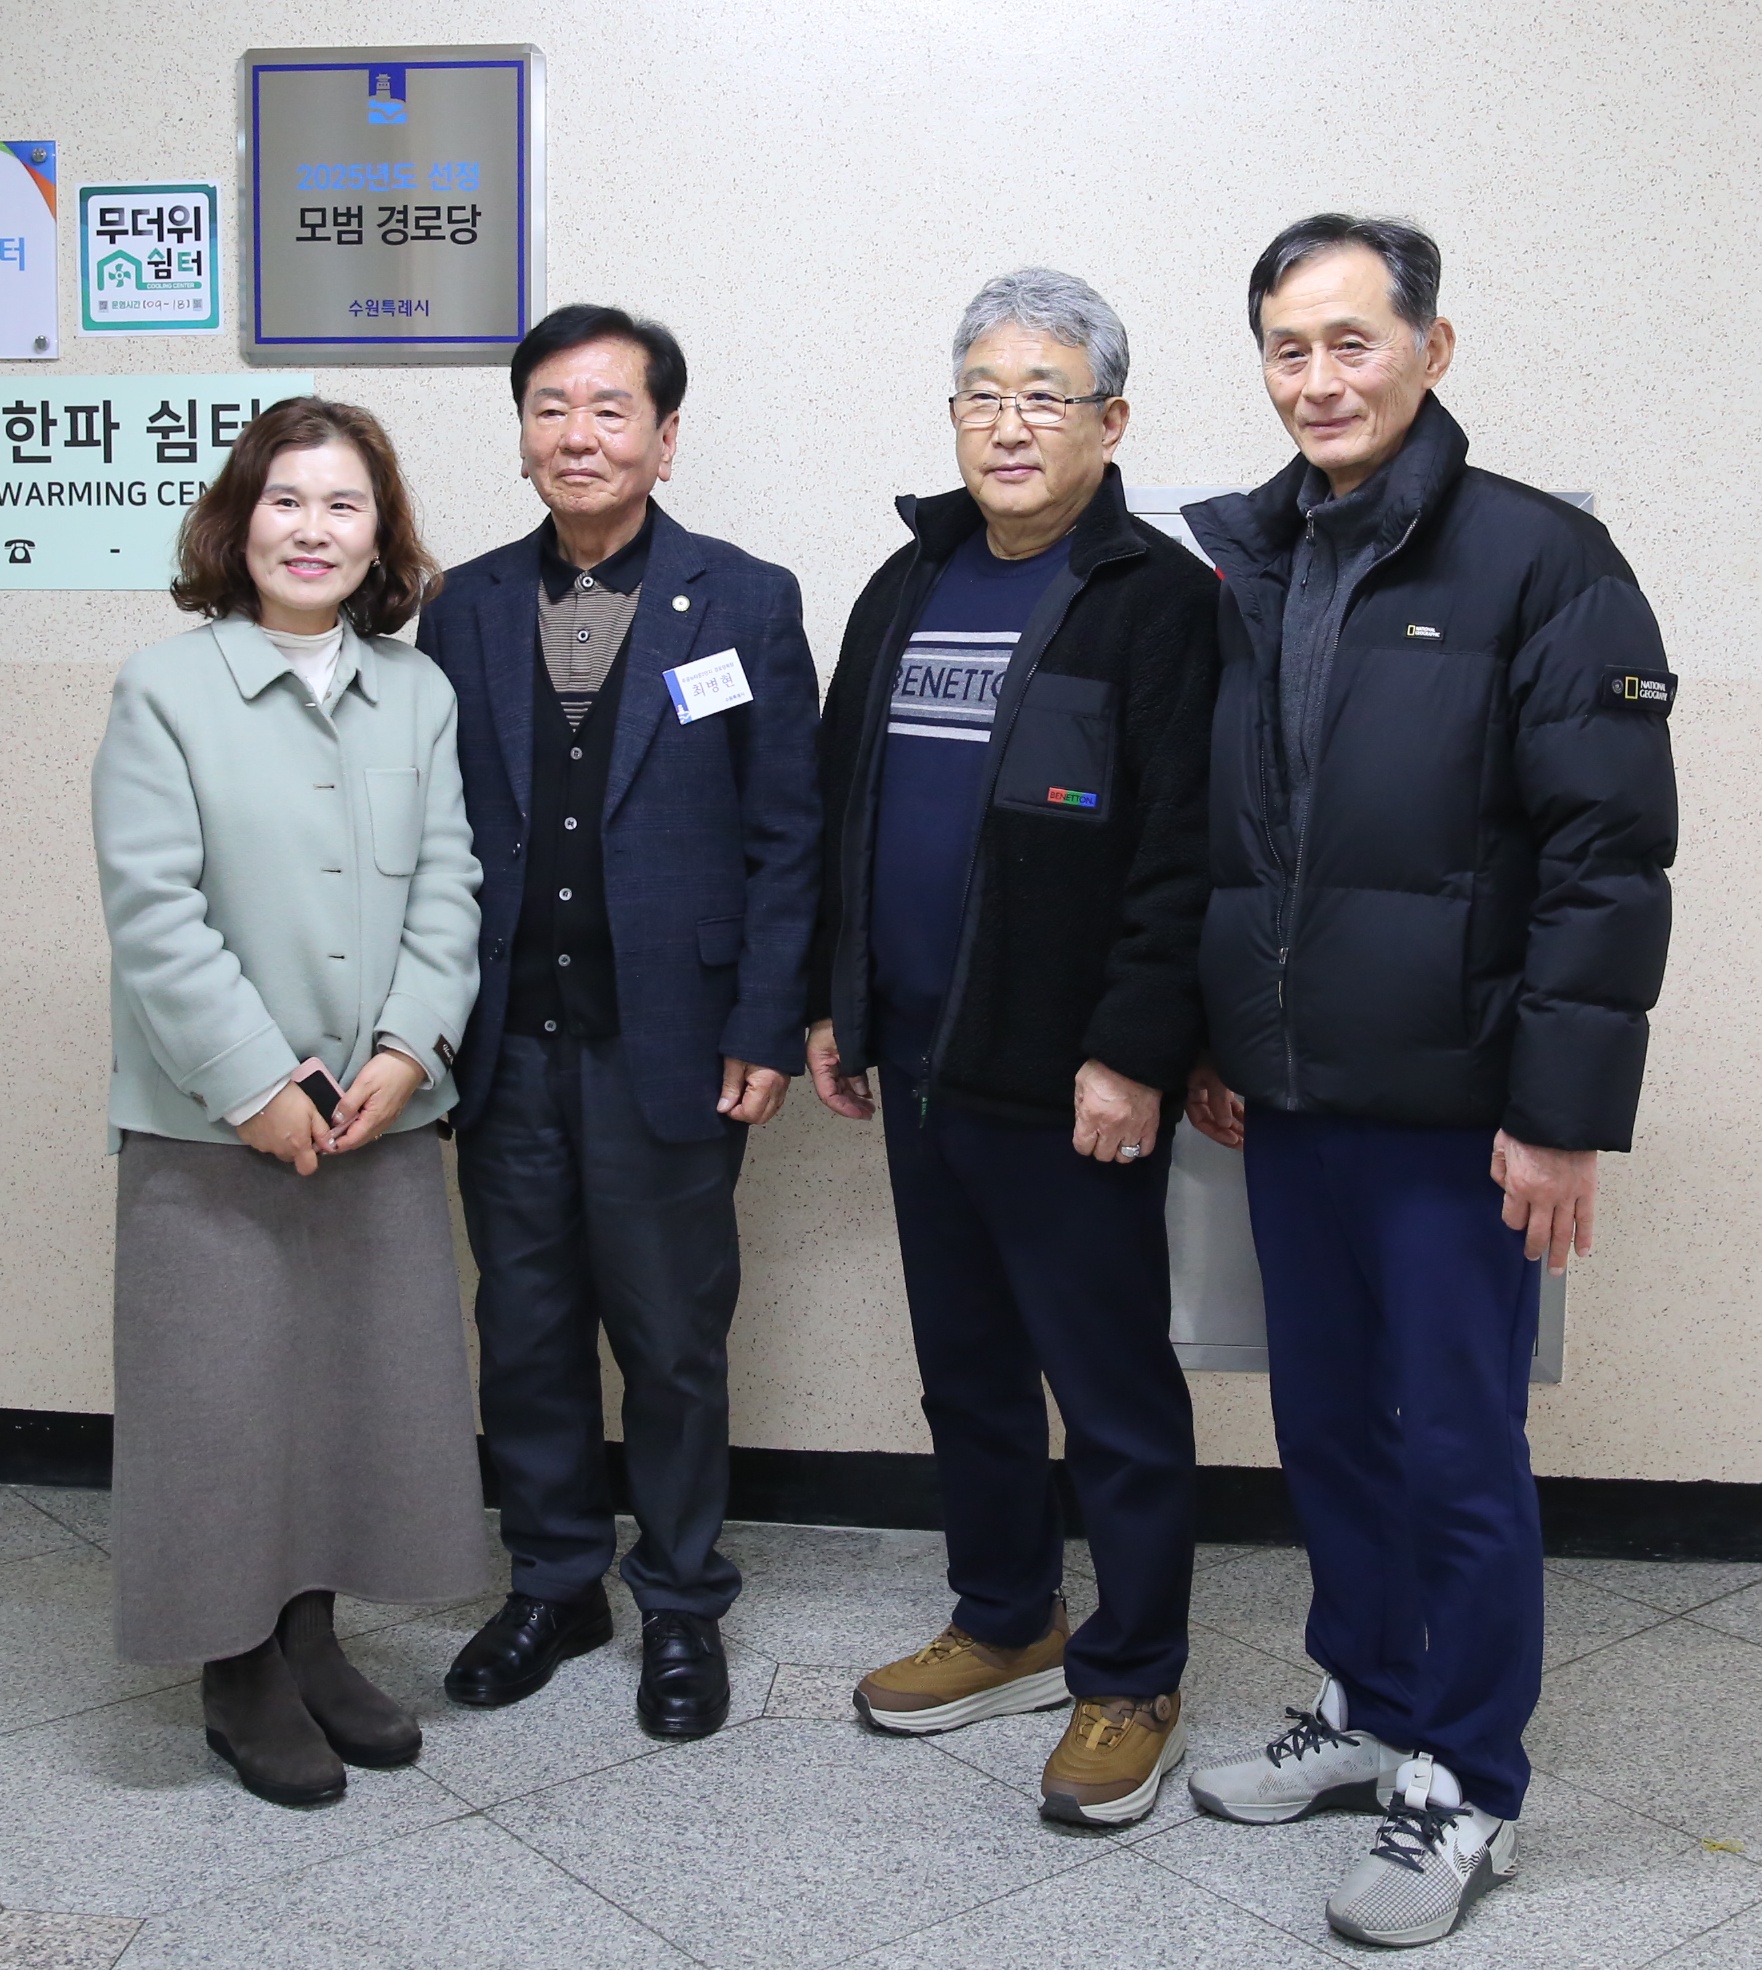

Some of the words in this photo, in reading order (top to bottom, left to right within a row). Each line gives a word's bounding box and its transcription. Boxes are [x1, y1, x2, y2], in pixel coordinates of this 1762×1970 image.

[296, 162, 419, 192] 2025년도
[427, 161, 480, 192] 선정
[96, 205, 202, 244] 무더위
[296, 205, 363, 245] 모범
[376, 203, 482, 246] 경로당
[147, 248, 202, 279] 쉼터
[111, 300, 141, 310] 운영시간
[349, 299, 430, 318] 수원특례시
[2, 399, 121, 464] 한파
[146, 398, 261, 464] 쉼터
[0, 481, 147, 507] WARMING
